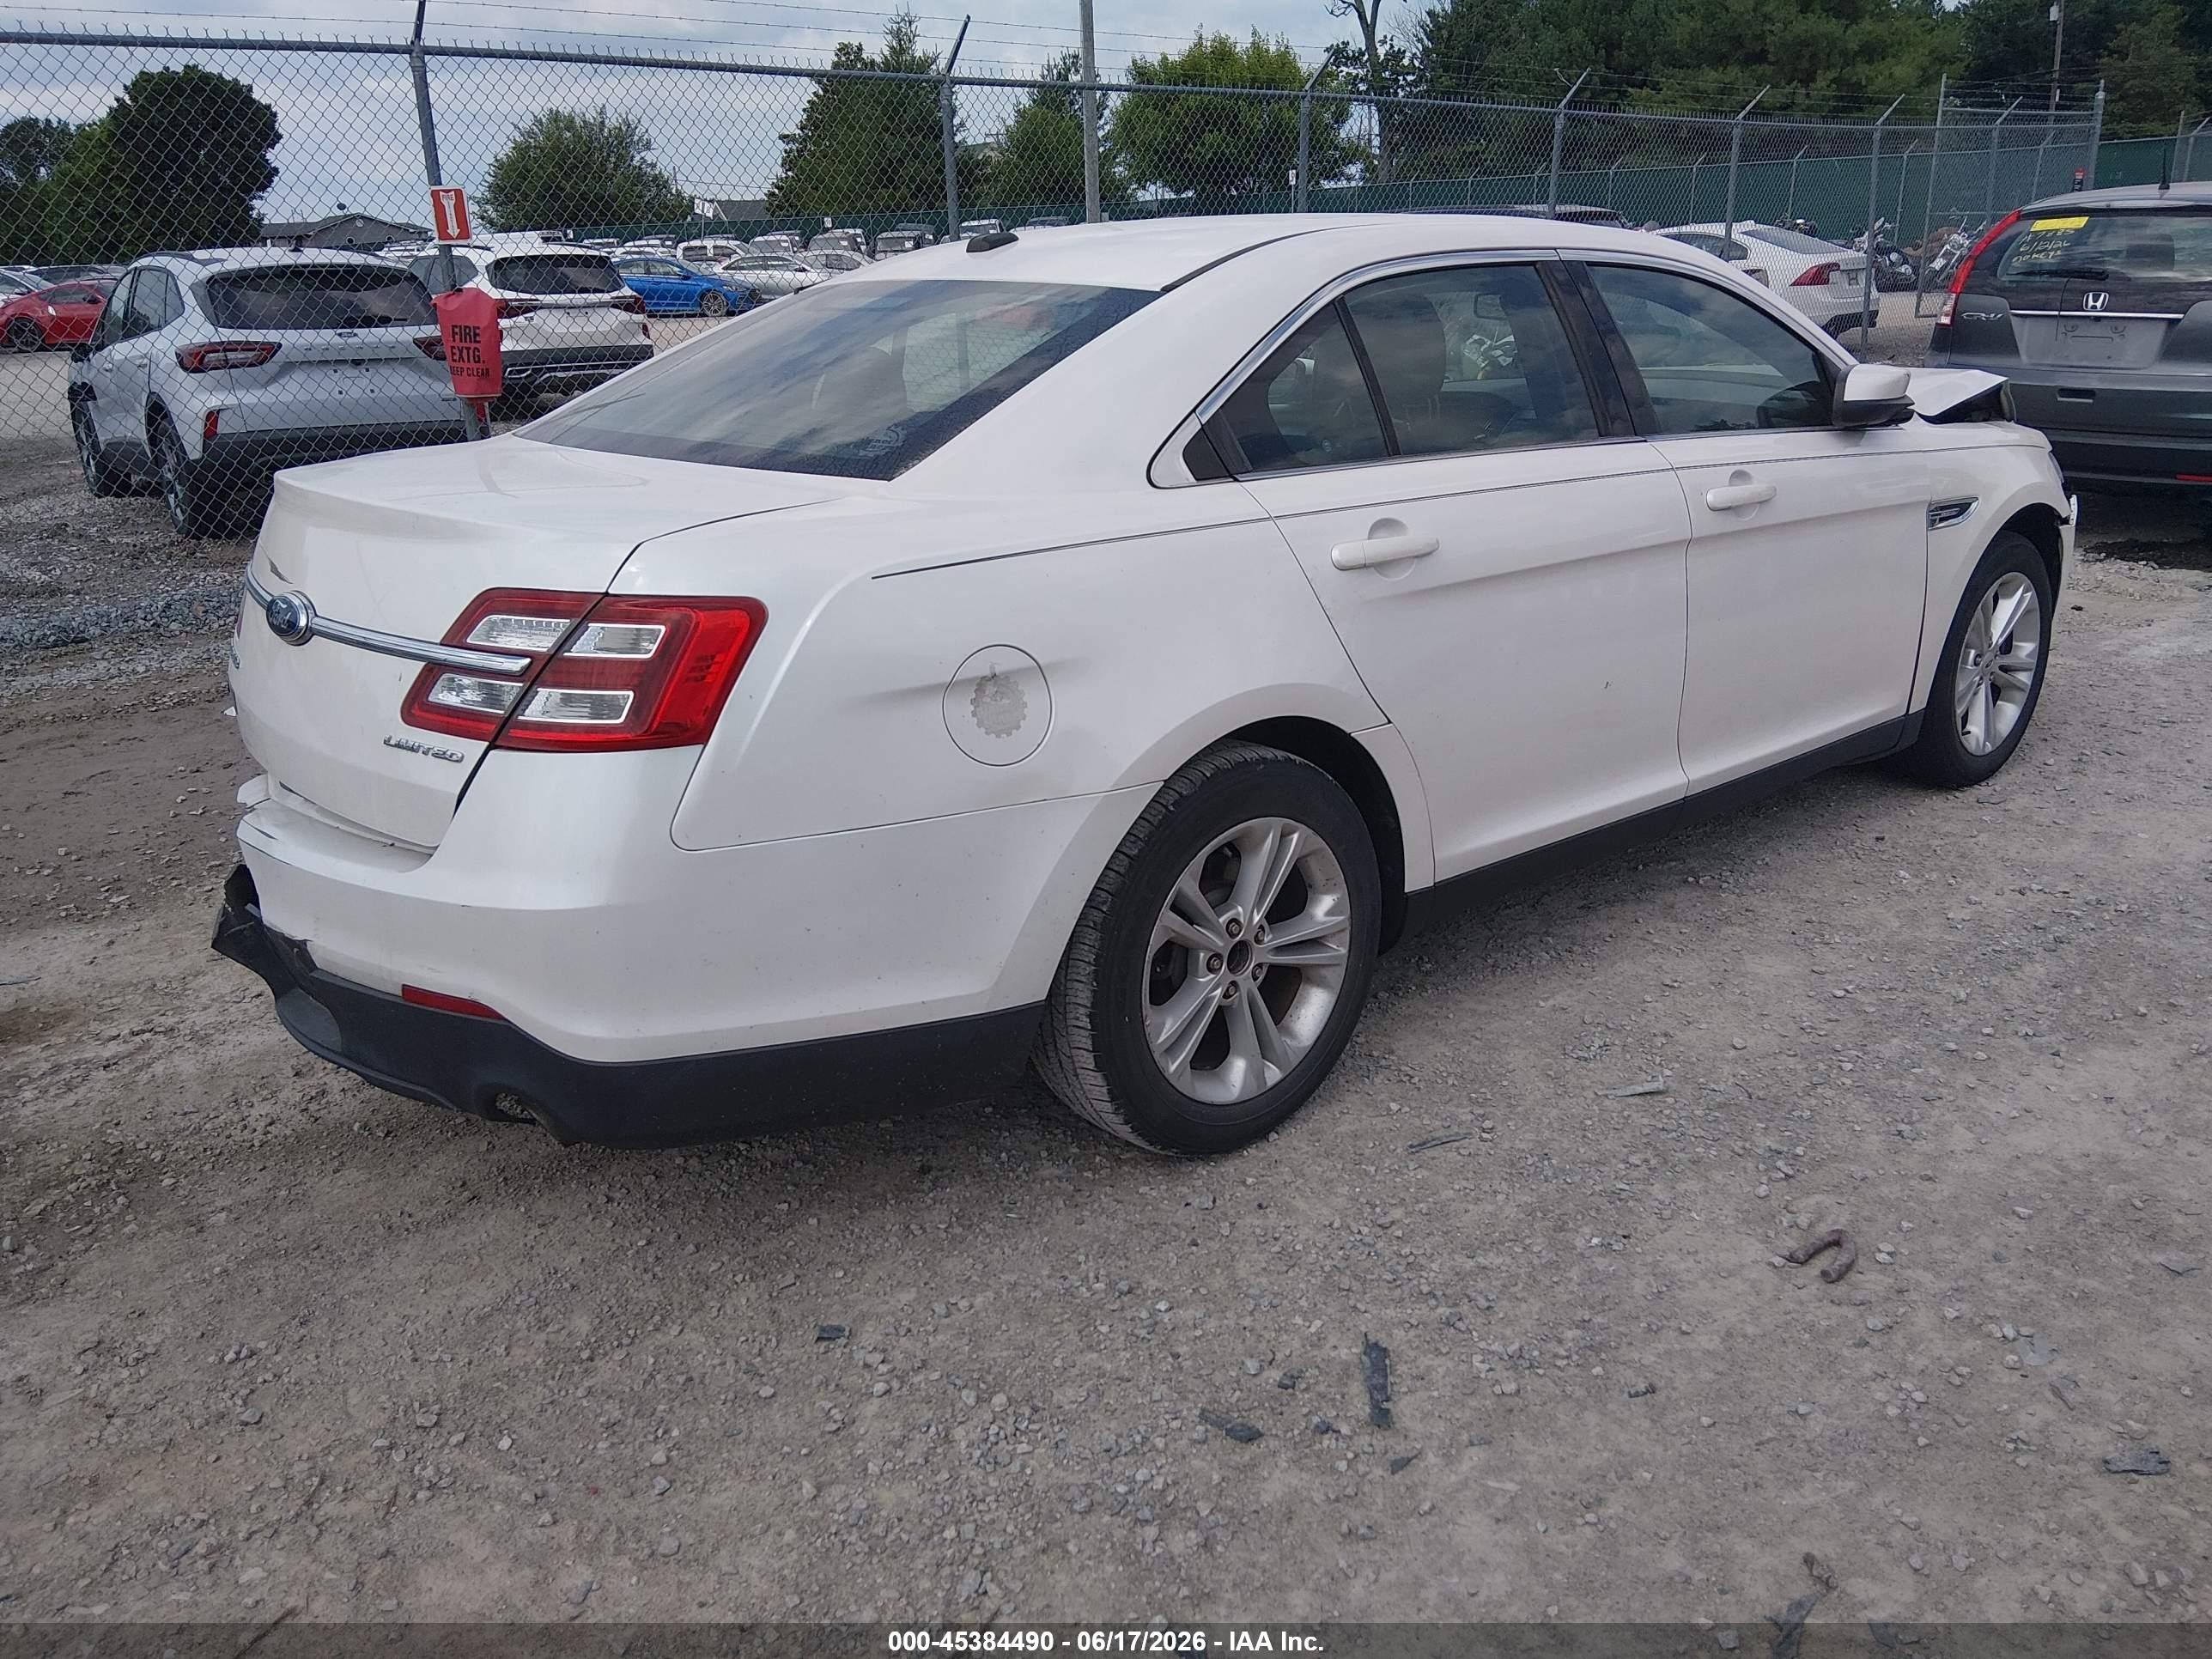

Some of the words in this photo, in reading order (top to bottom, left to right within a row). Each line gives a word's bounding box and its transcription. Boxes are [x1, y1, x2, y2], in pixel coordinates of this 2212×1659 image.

[451, 325, 482, 343] FIRE
[450, 345, 486, 364] EXTG.
[466, 367, 490, 378] CLEAR
[269, 599, 293, 629] Ford
[383, 735, 465, 763] LIMITED
